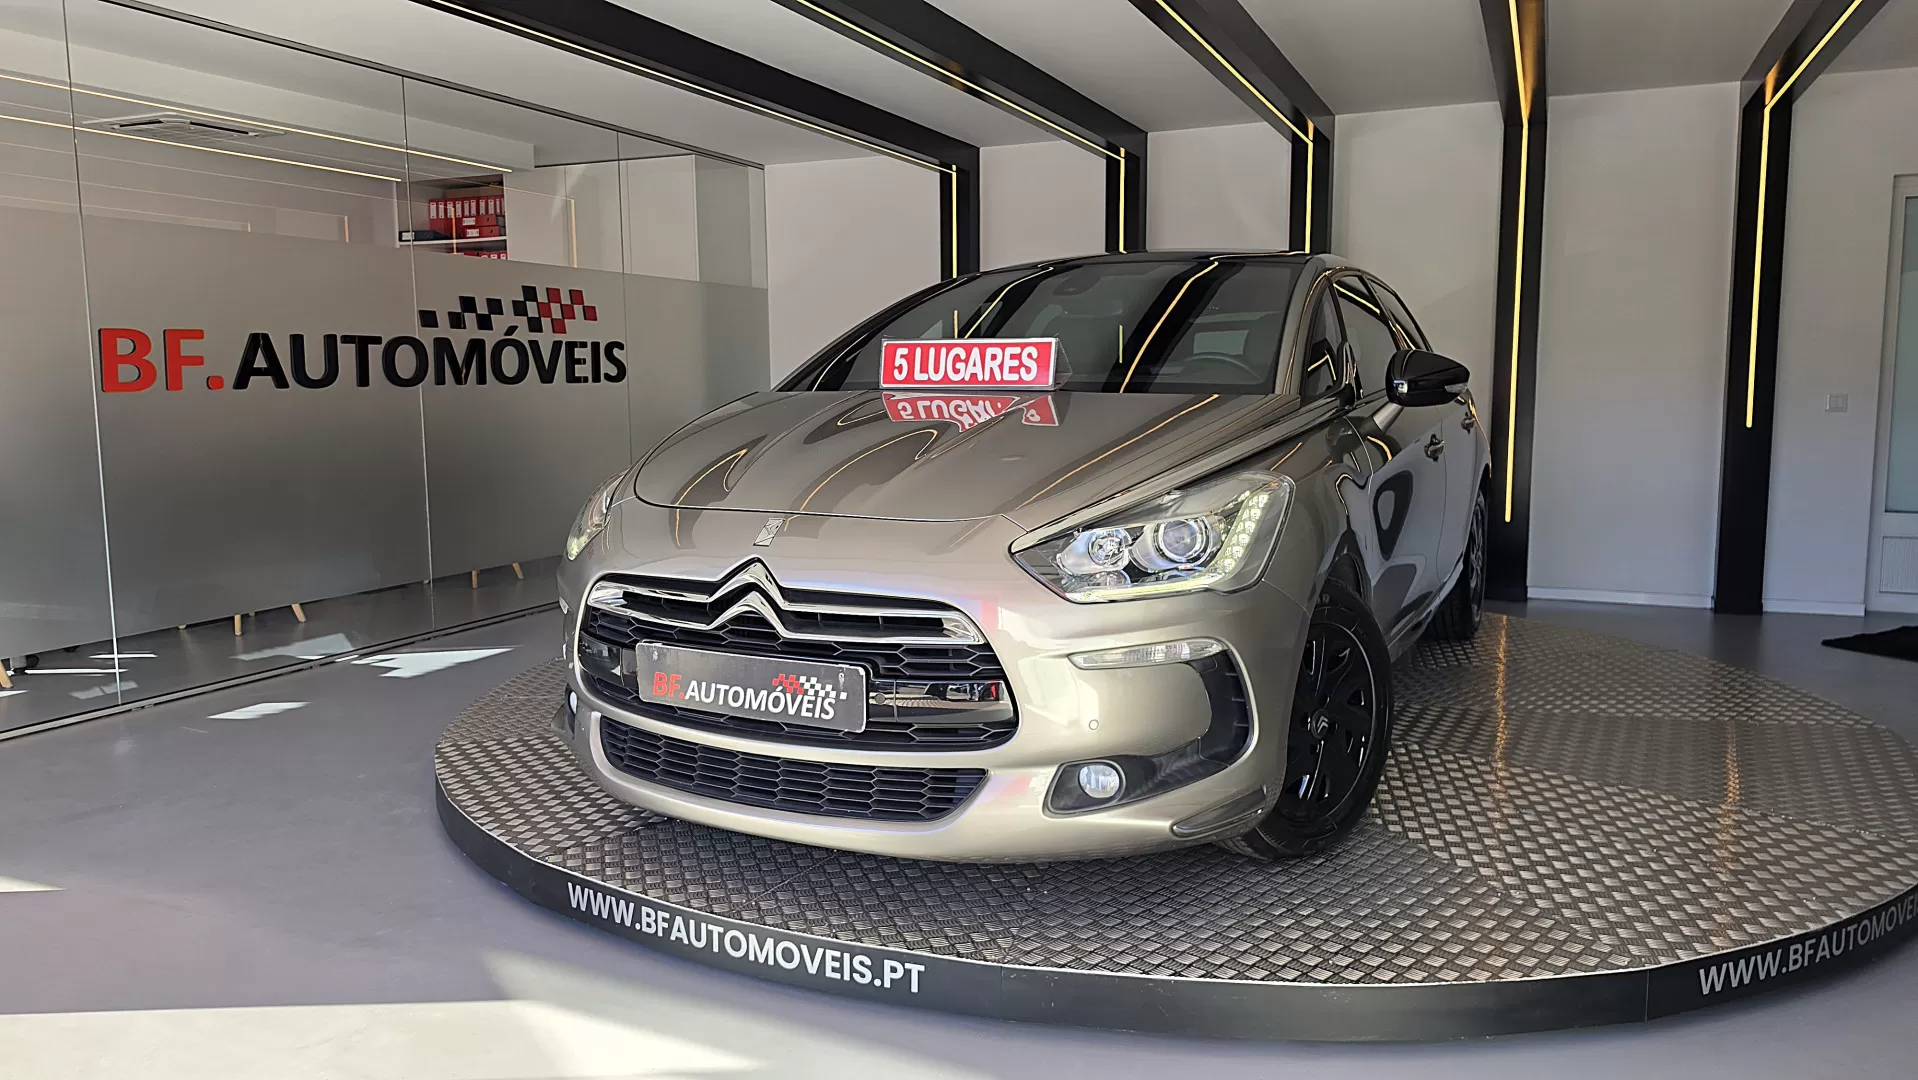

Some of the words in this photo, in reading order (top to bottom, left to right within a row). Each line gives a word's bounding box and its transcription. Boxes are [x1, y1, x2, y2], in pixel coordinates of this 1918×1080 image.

[893, 347, 909, 381] 5
[914, 346, 1038, 381] LUGARES
[567, 881, 925, 994] WWW.BFAUTOMOVEIS.PT
[1699, 891, 1918, 996] WWW.BFAUTOMOVEI
